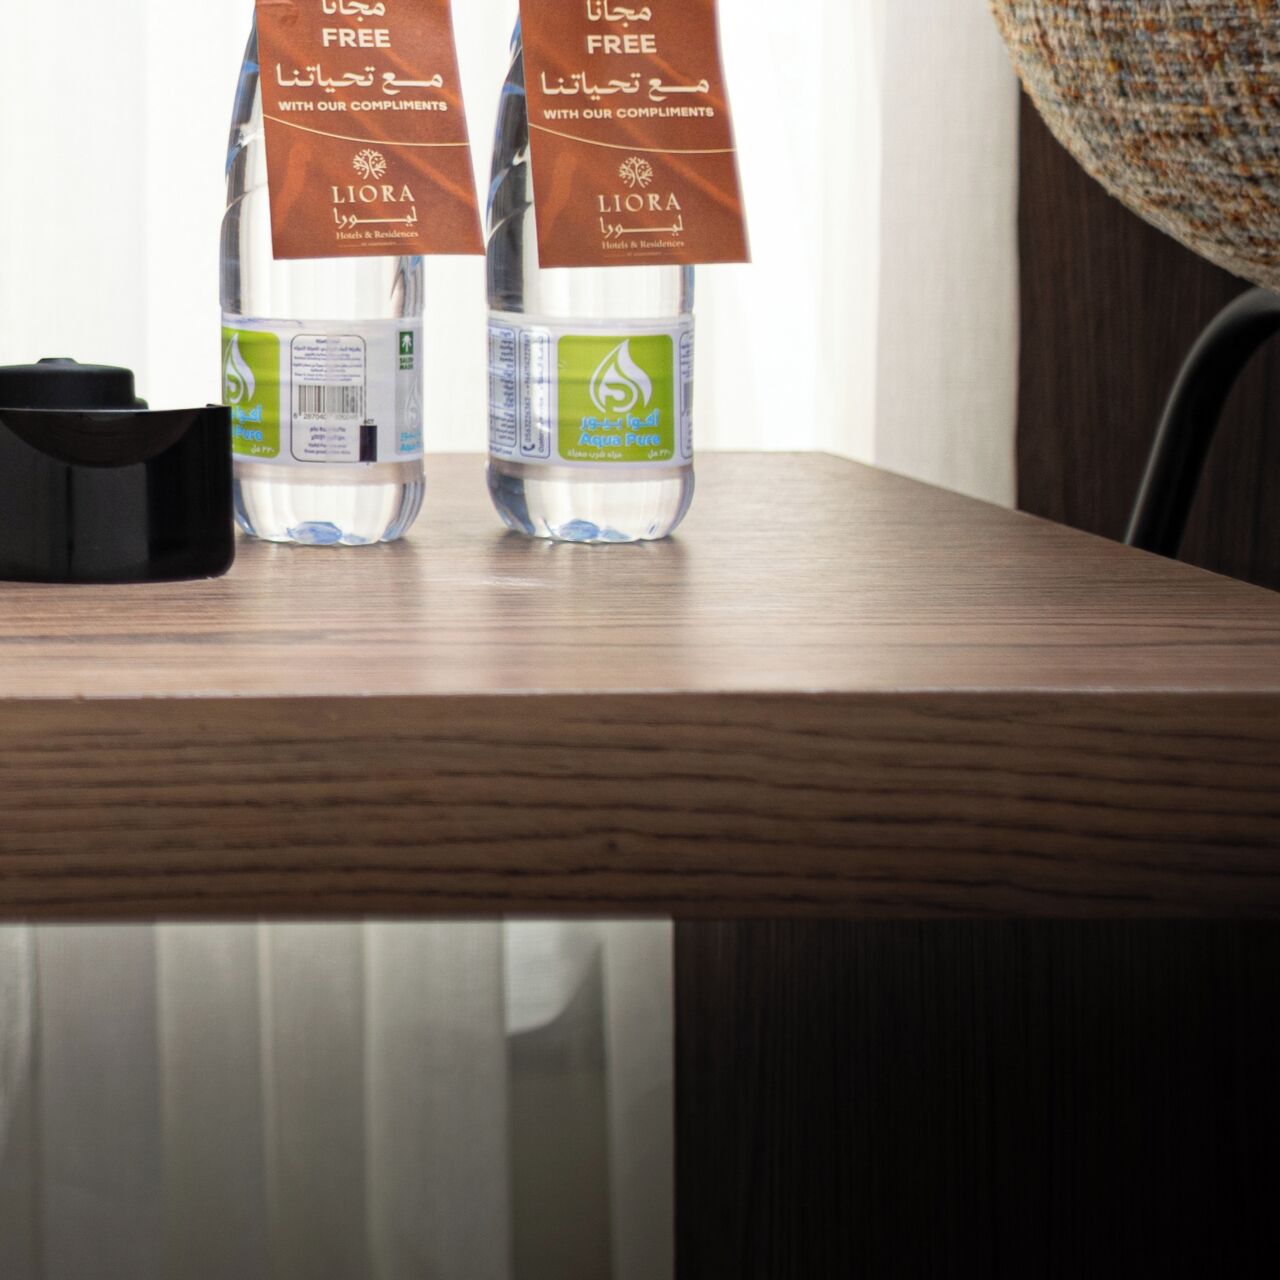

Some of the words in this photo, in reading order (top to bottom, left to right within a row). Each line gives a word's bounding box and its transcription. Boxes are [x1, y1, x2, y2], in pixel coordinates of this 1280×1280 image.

[322, 28, 392, 48] FREE
[586, 34, 657, 55] FREE
[275, 63, 375, 94] تحياتنا
[381, 69, 444, 96] مع
[540, 71, 640, 101] تحياتنا
[647, 75, 710, 102] مع
[278, 101, 314, 112] WITH
[317, 101, 347, 112] OUR
[350, 100, 448, 112] COMPLIMENTS
[543, 109, 579, 120] WITH
[583, 108, 613, 119] OUR
[616, 106, 714, 119] COMPLIMENTS
[331, 183, 416, 204] LIORA
[598, 191, 682, 213] LIORA
[336, 231, 363, 240] Hotels
[364, 231, 372, 239] &
[374, 229, 419, 239] Residences
[602, 240, 628, 250] Hotels
[630, 240, 638, 249] &
[640, 239, 685, 248] Residences
[578, 432, 622, 448] Aqua
[625, 432, 661, 446] Pure
